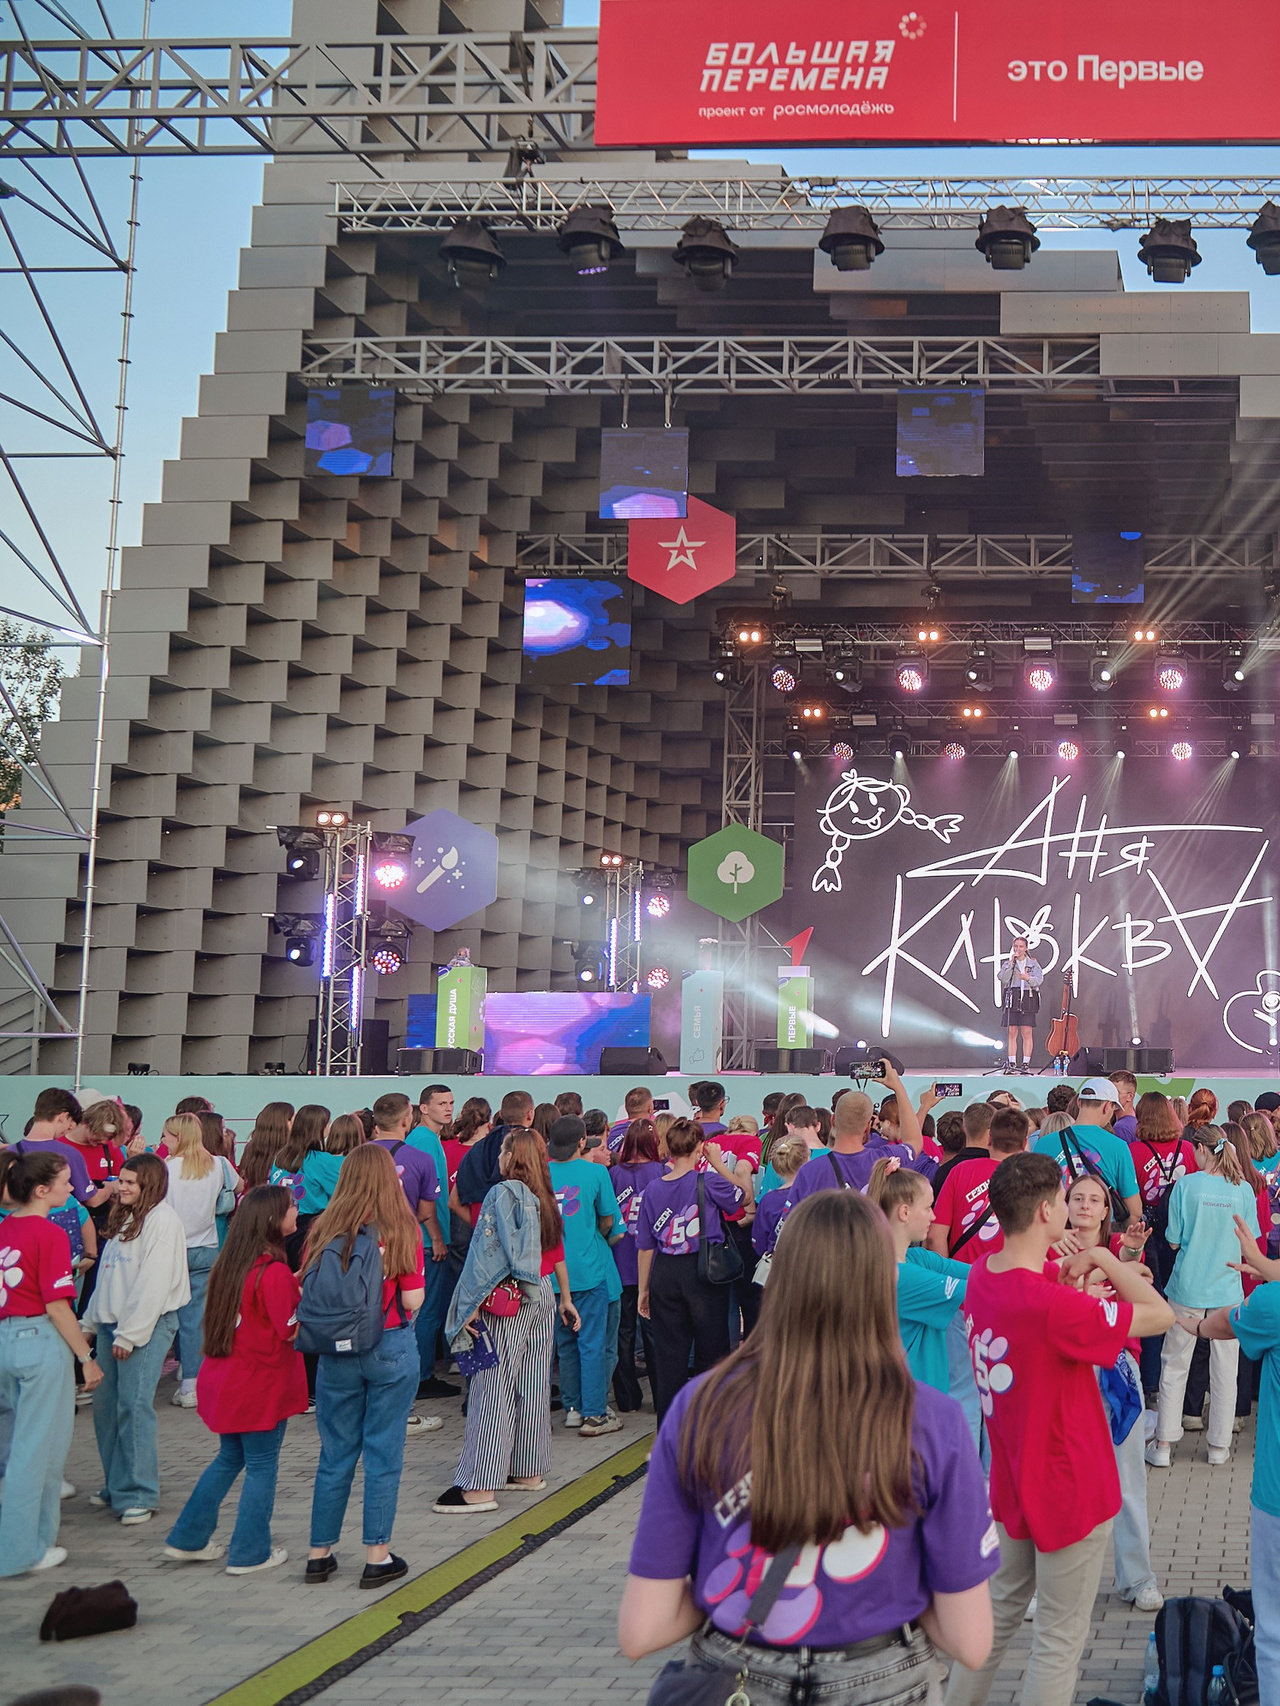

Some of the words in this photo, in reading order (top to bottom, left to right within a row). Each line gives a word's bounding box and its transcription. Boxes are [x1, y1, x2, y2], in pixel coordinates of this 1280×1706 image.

[705, 39, 896, 66] БОЛЬШАЯ
[699, 66, 889, 92] ПЕРЕМЕНА
[1007, 60, 1069, 82] это
[1077, 54, 1205, 90] Первые
[699, 106, 746, 118] проект
[749, 106, 765, 117] от
[773, 100, 895, 120] росмолодёжь
[693, 1005, 701, 1038] СЕМЬЯ
[788, 1006, 796, 1042] ПЕРВЫЕ
[653, 1207, 674, 1233] СЕЗОН
[670, 1215, 686, 1245] 5
[973, 1338, 991, 1396] 5
